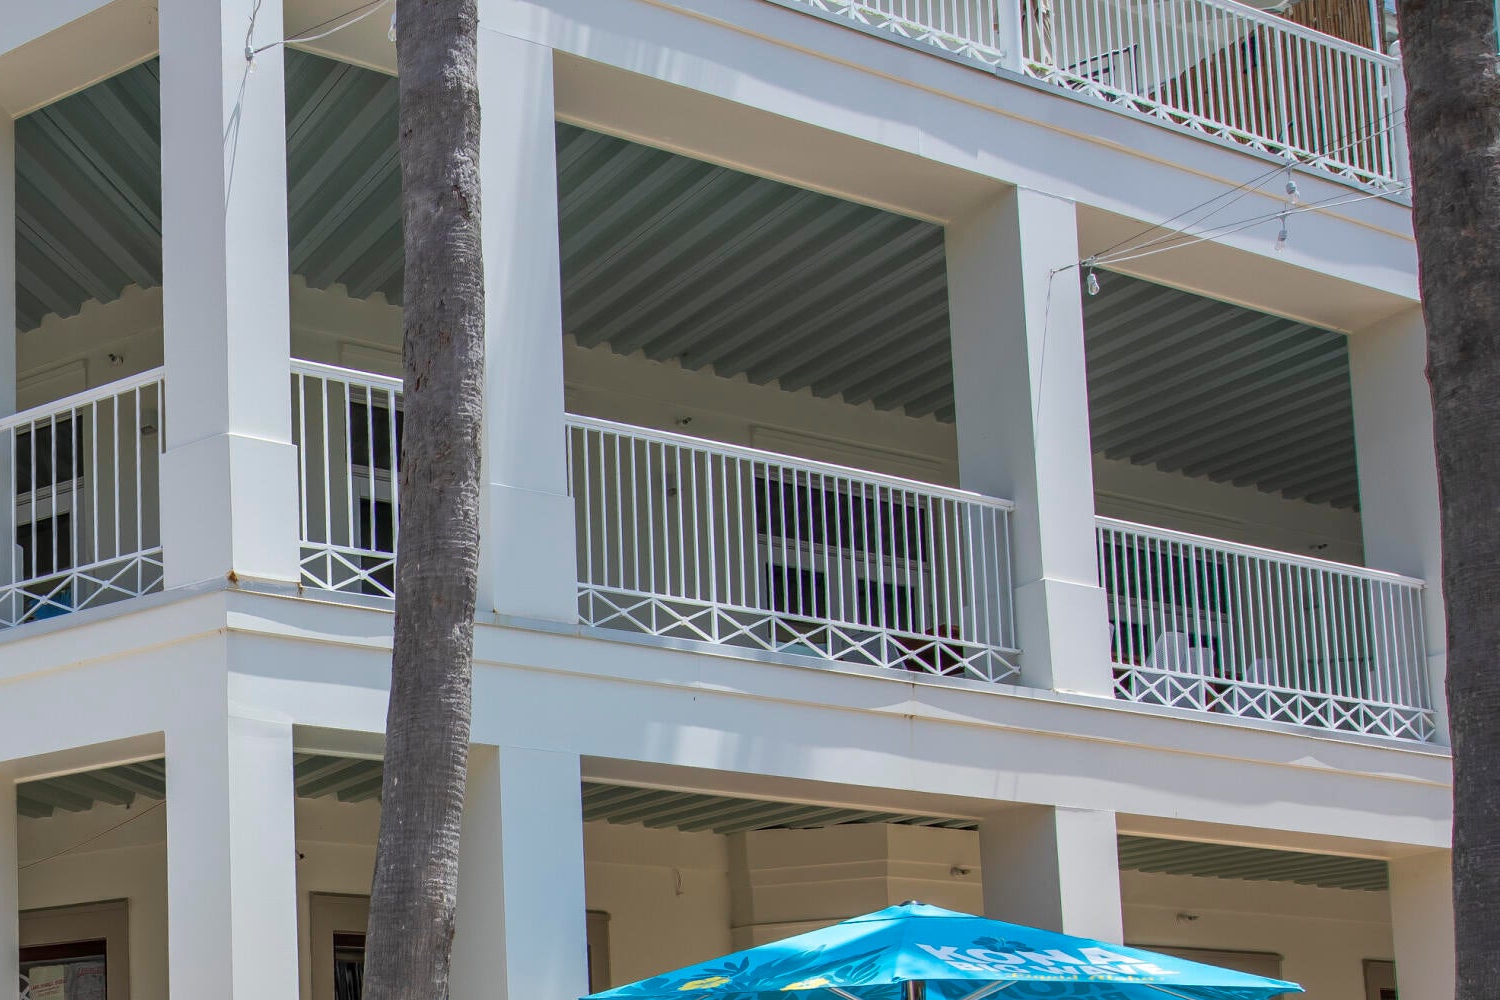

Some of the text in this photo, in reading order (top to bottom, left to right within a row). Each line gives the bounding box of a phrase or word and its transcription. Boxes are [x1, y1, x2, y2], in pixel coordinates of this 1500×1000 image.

[915, 943, 1148, 965] KONA
[946, 961, 1181, 975] BIG WAVE
